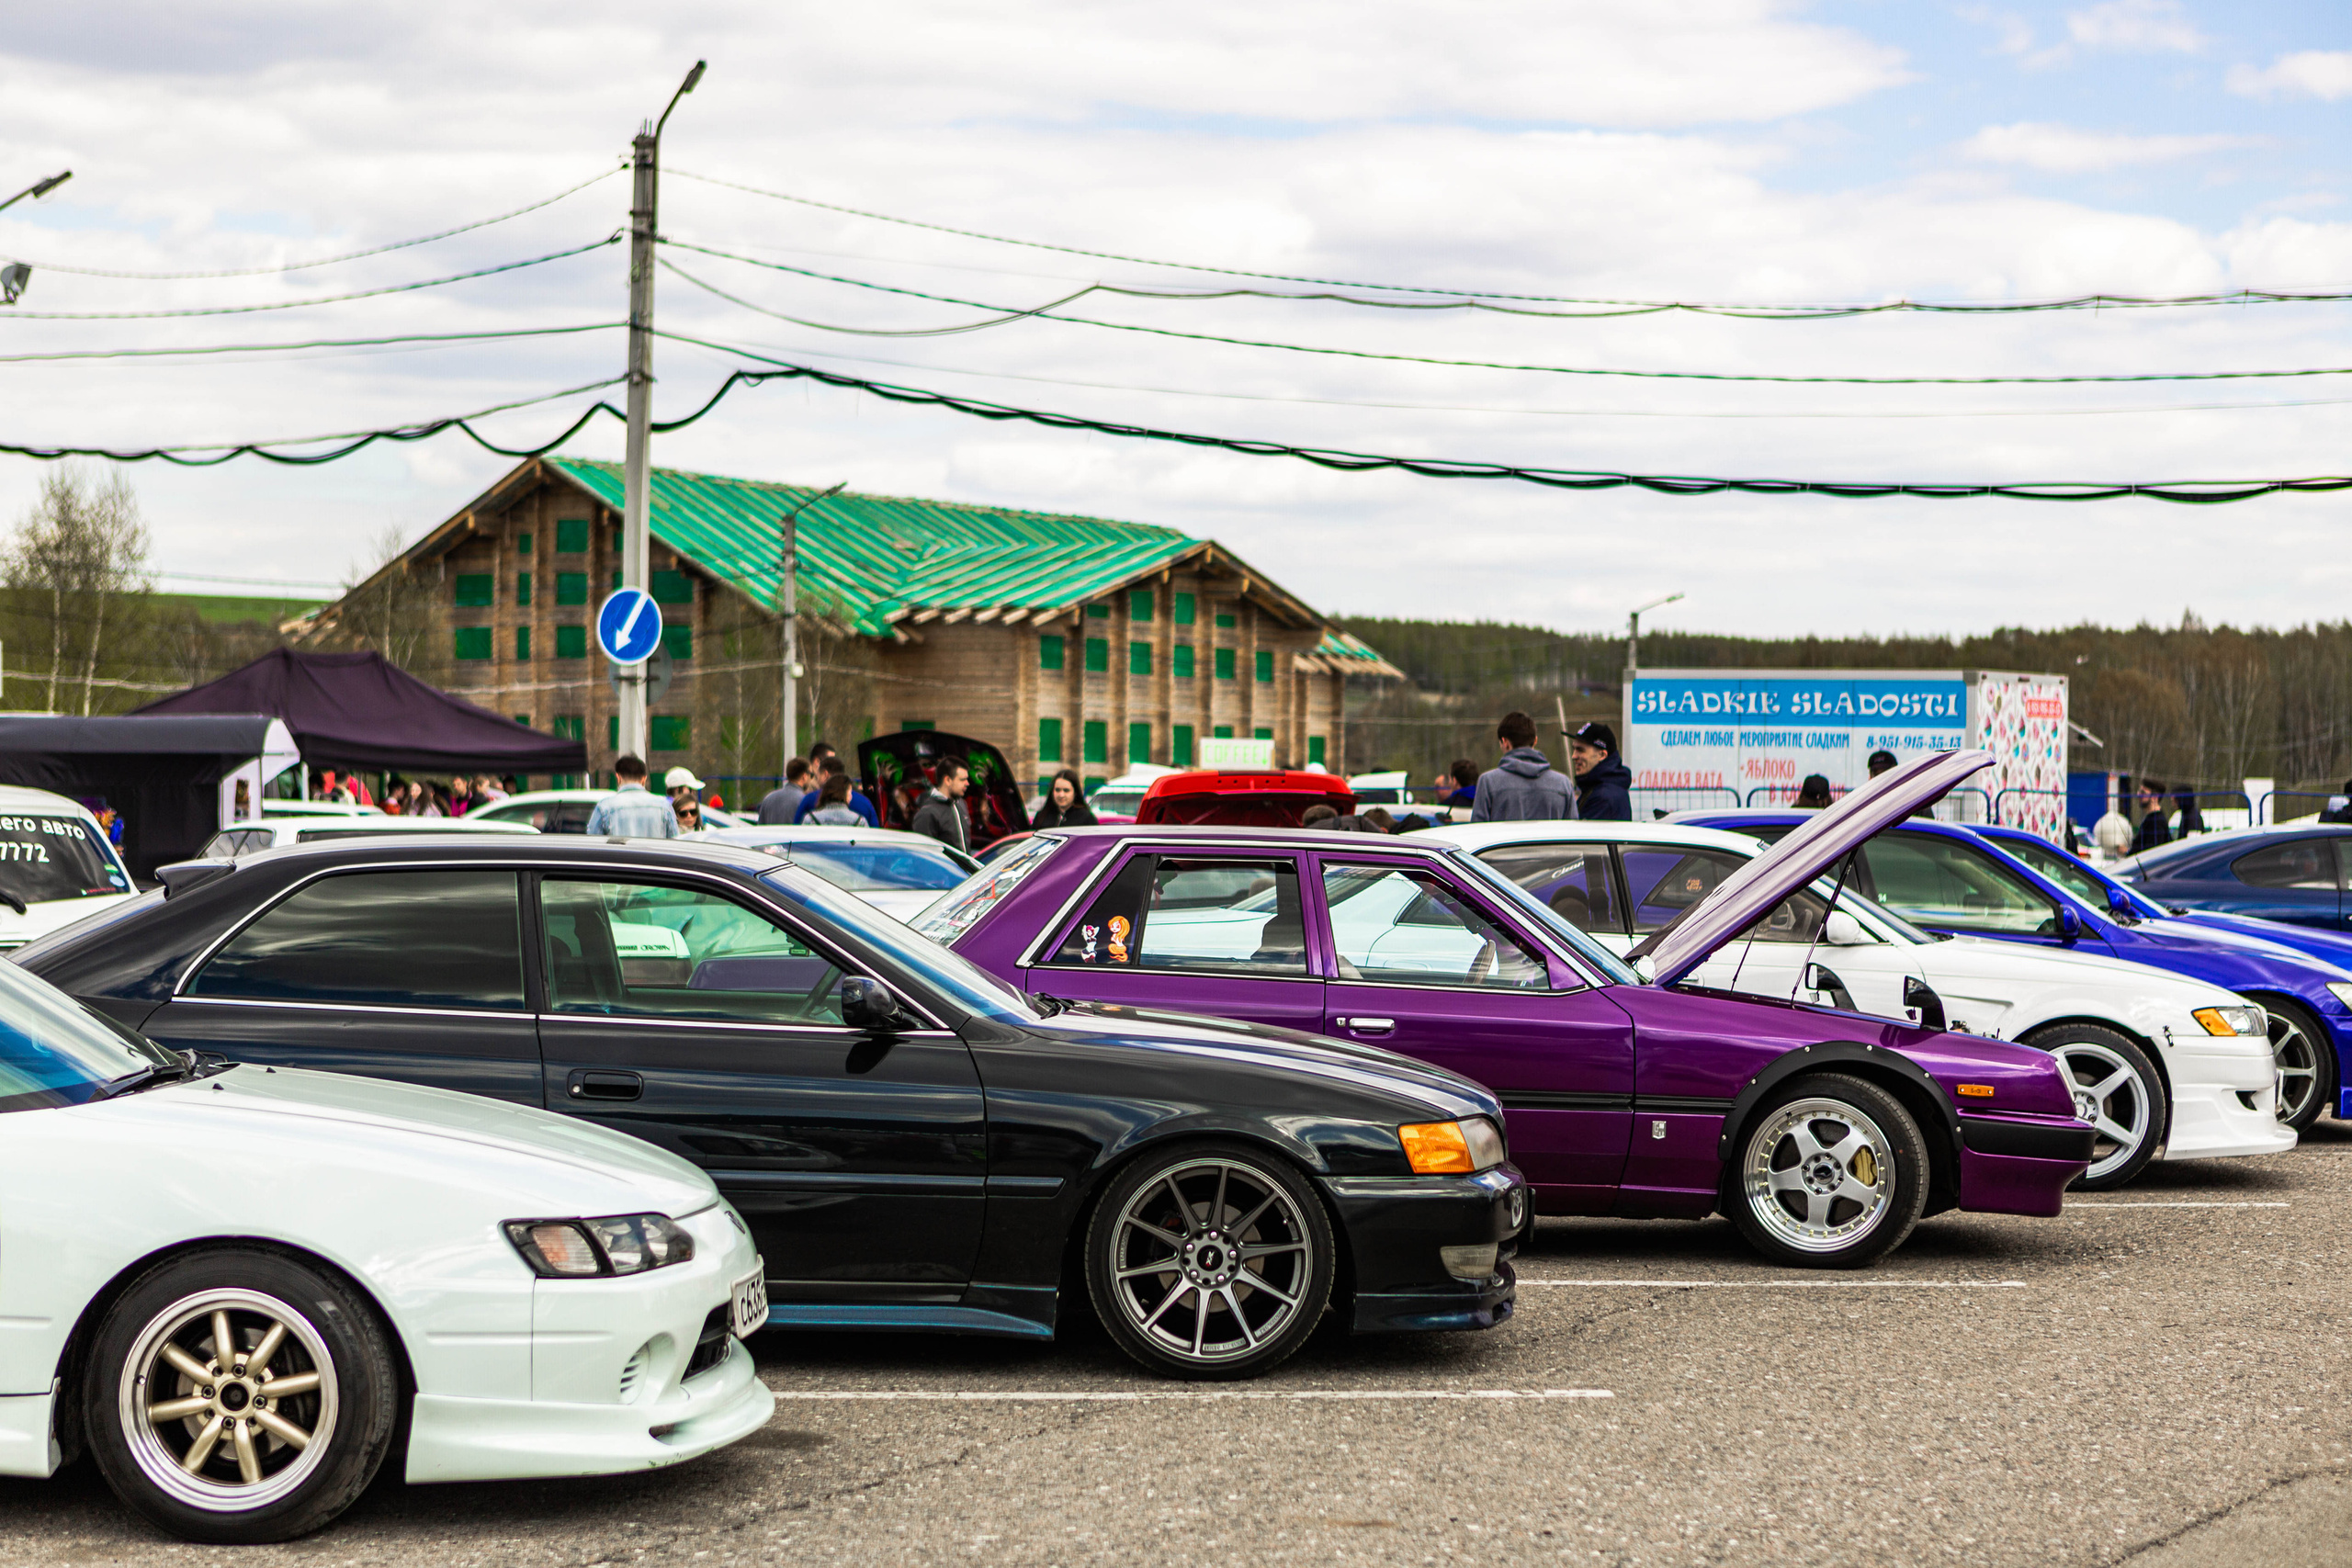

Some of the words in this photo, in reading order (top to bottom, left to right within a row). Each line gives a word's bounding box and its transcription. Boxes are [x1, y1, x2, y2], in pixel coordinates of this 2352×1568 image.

[1636, 690, 1781, 715] SLADKIE
[1791, 691, 1959, 717] SLADOSTI
[1660, 730, 1702, 747] СДЕЛАЕМ
[1703, 730, 1735, 747] ЛЮБОЕ
[1739, 731, 1803, 748] МЕРОПРИЯТИЕ
[1805, 732, 1849, 750] СЛАДКИМ
[1746, 759, 1795, 779] ЯБЛОКО
[1638, 771, 1690, 793] СЛАДКАЯ
[1695, 771, 1723, 791] ВАТА
[0, 816, 37, 832] его
[42, 818, 85, 840] авто
